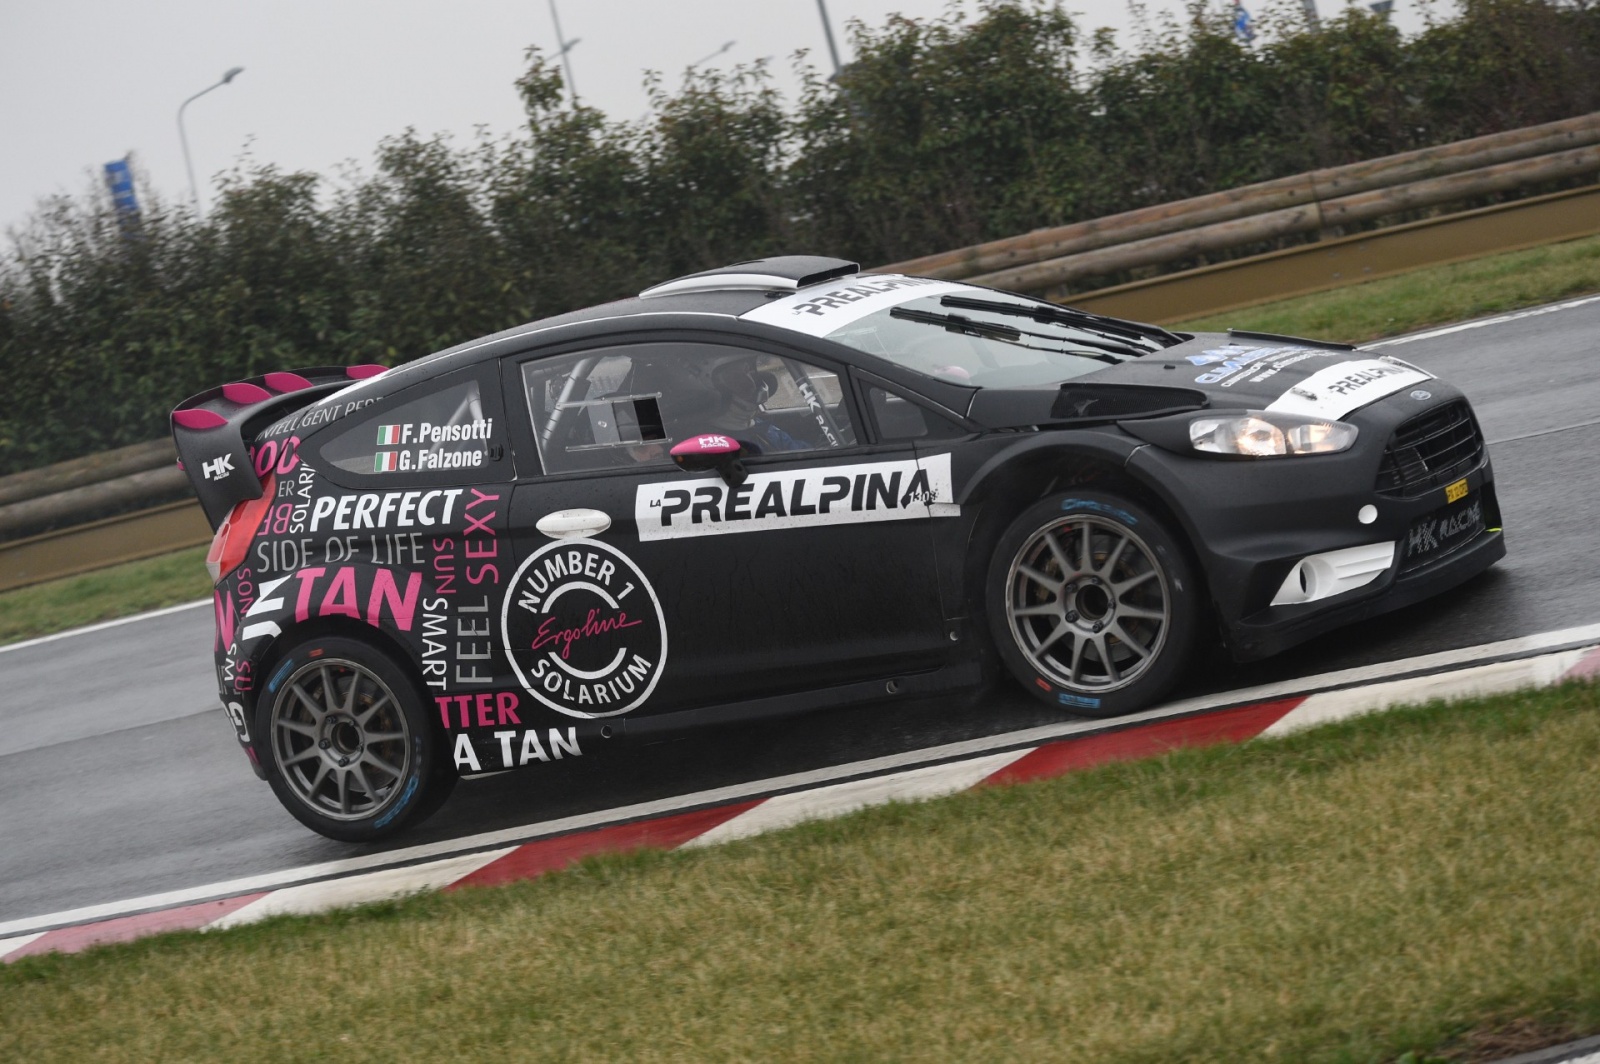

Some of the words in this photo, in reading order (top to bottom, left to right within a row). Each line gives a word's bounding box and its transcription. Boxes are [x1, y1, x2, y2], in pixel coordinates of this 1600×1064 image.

[799, 382, 821, 413] HK
[401, 417, 493, 445] F.Pensotti
[697, 436, 730, 448] HK
[202, 452, 236, 480] HK
[399, 447, 483, 471] G.Falzone
[309, 488, 465, 533] PERFECT
[660, 468, 931, 527] PREALPINA
[256, 538, 314, 573] SIDE
[324, 535, 360, 563] OF
[371, 532, 426, 566] LIFE
[462, 487, 501, 585] SEXY
[432, 537, 457, 595] SUN
[517, 550, 616, 614] NUMBER
[616, 581, 635, 601] 1
[295, 566, 423, 632] TAN
[421, 597, 449, 691] SMART
[454, 594, 494, 684] FEEL
[531, 608, 643, 660] Ergoline
[530, 653, 653, 706] SOLARIUM
[453, 733, 482, 771] A
[494, 727, 583, 769] TAN
